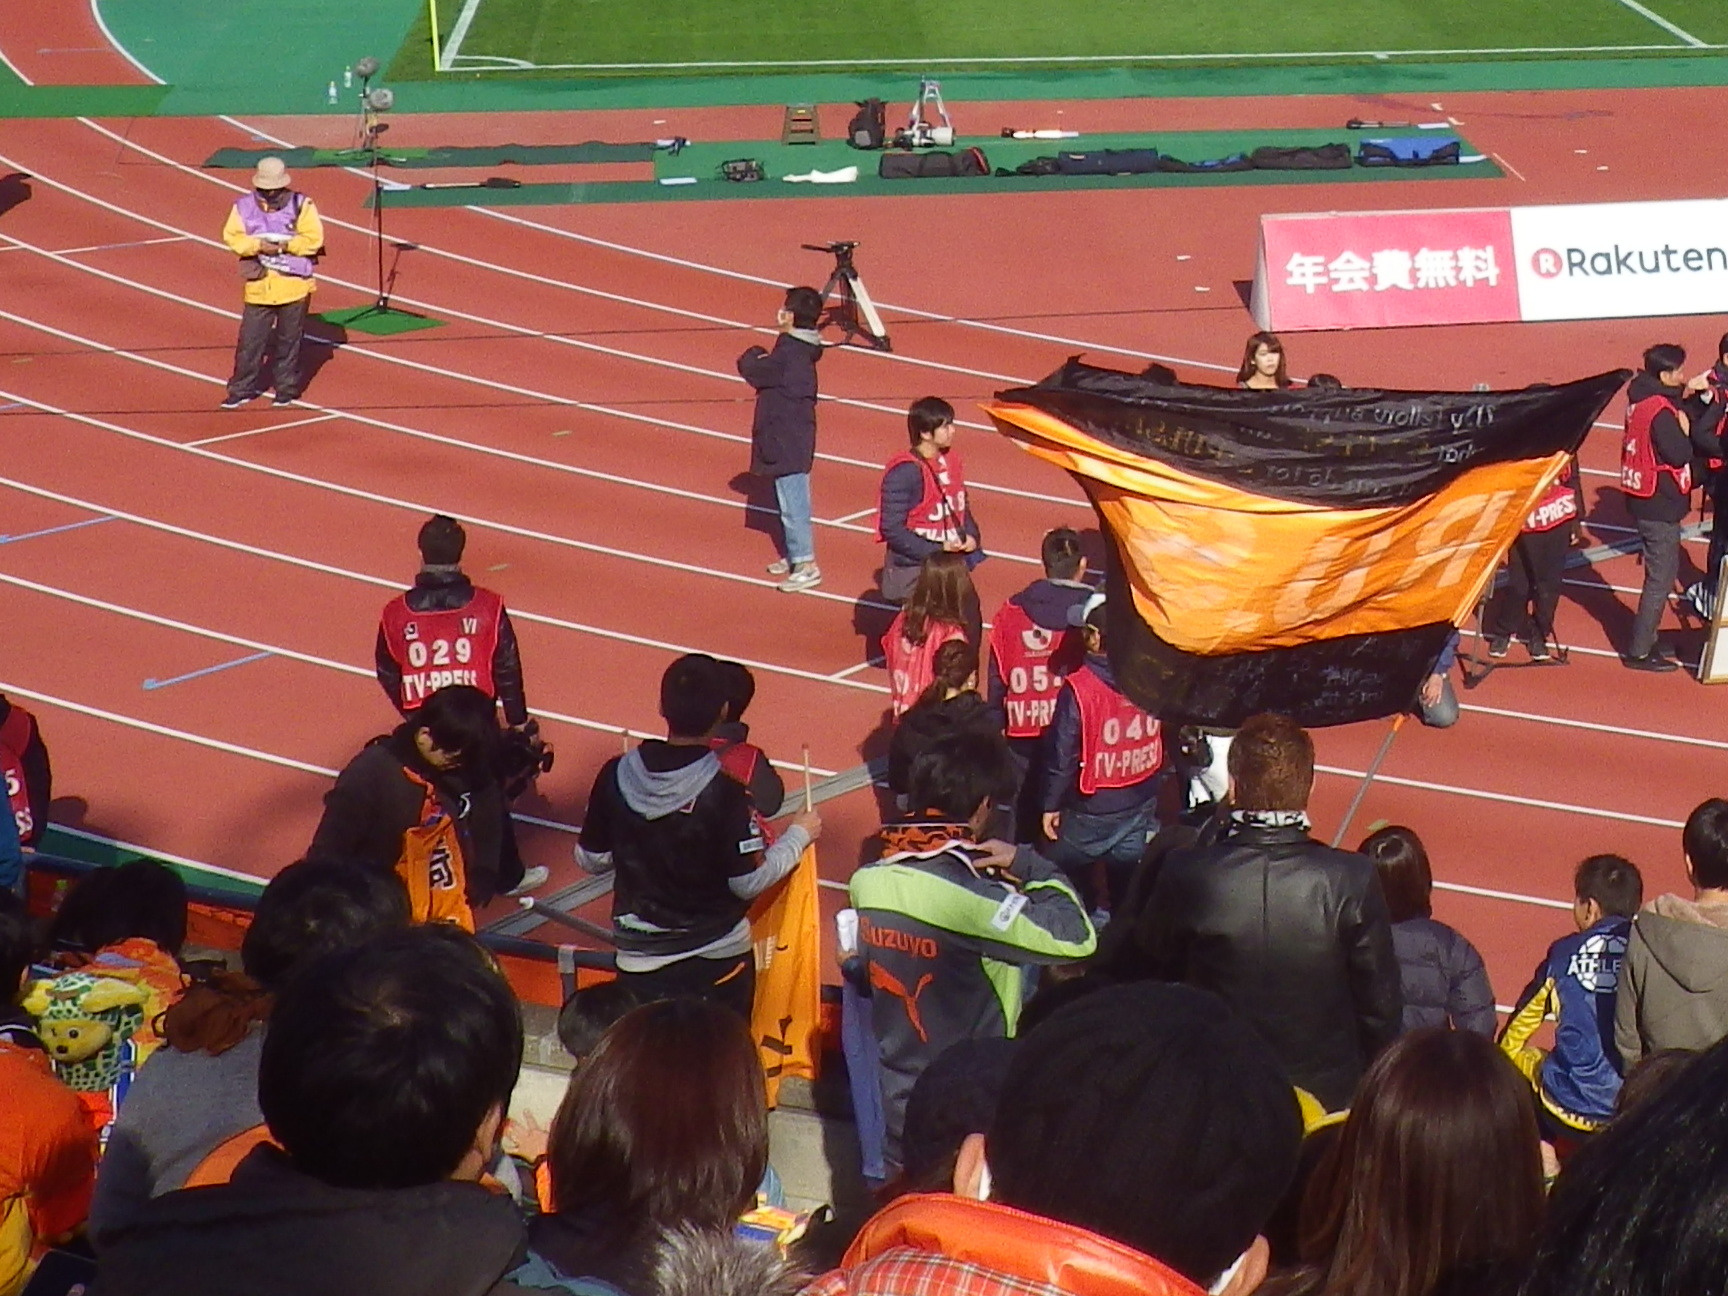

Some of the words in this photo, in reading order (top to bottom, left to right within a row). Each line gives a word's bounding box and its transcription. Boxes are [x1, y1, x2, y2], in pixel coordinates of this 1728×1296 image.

[1284, 244, 1500, 295] 年会費無料
[1566, 244, 1728, 278] Rakuten
[408, 637, 472, 668] 029
